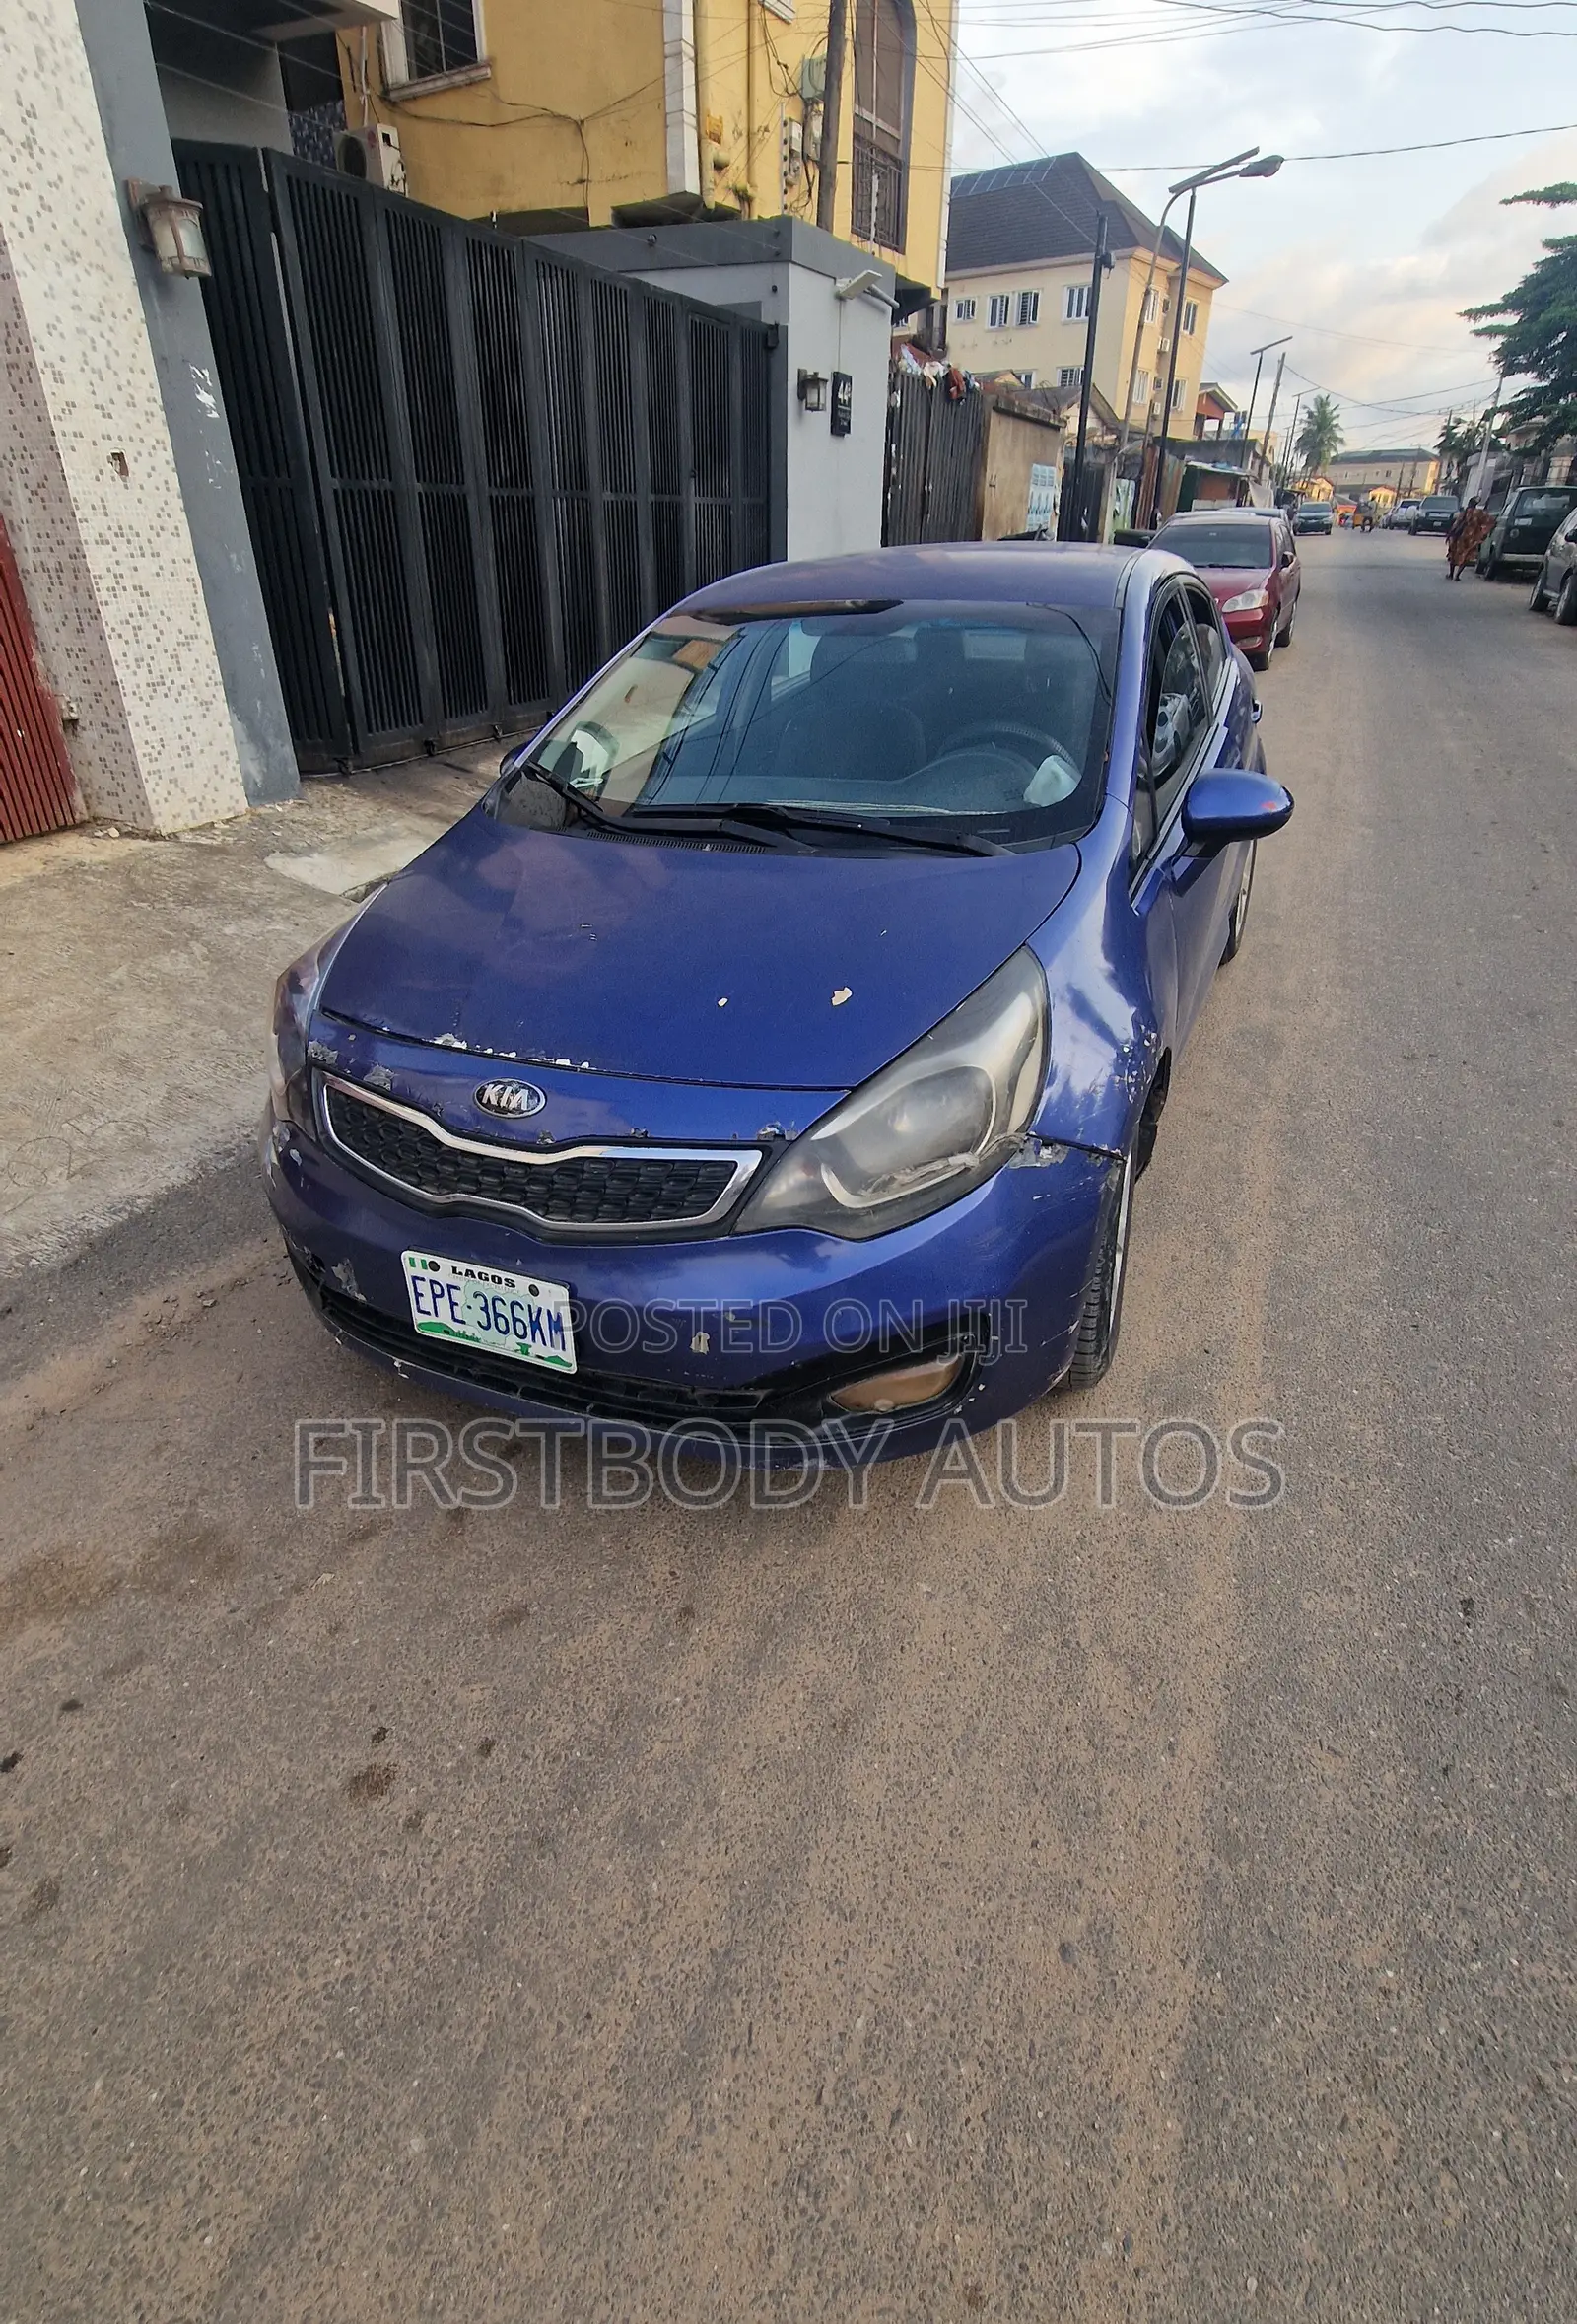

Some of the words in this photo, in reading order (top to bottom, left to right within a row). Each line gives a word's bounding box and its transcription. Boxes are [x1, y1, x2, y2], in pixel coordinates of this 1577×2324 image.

[482, 1083, 529, 1111] KIA
[451, 1265, 516, 1288] LAGOS
[411, 1275, 566, 1351] EPE-366KM
